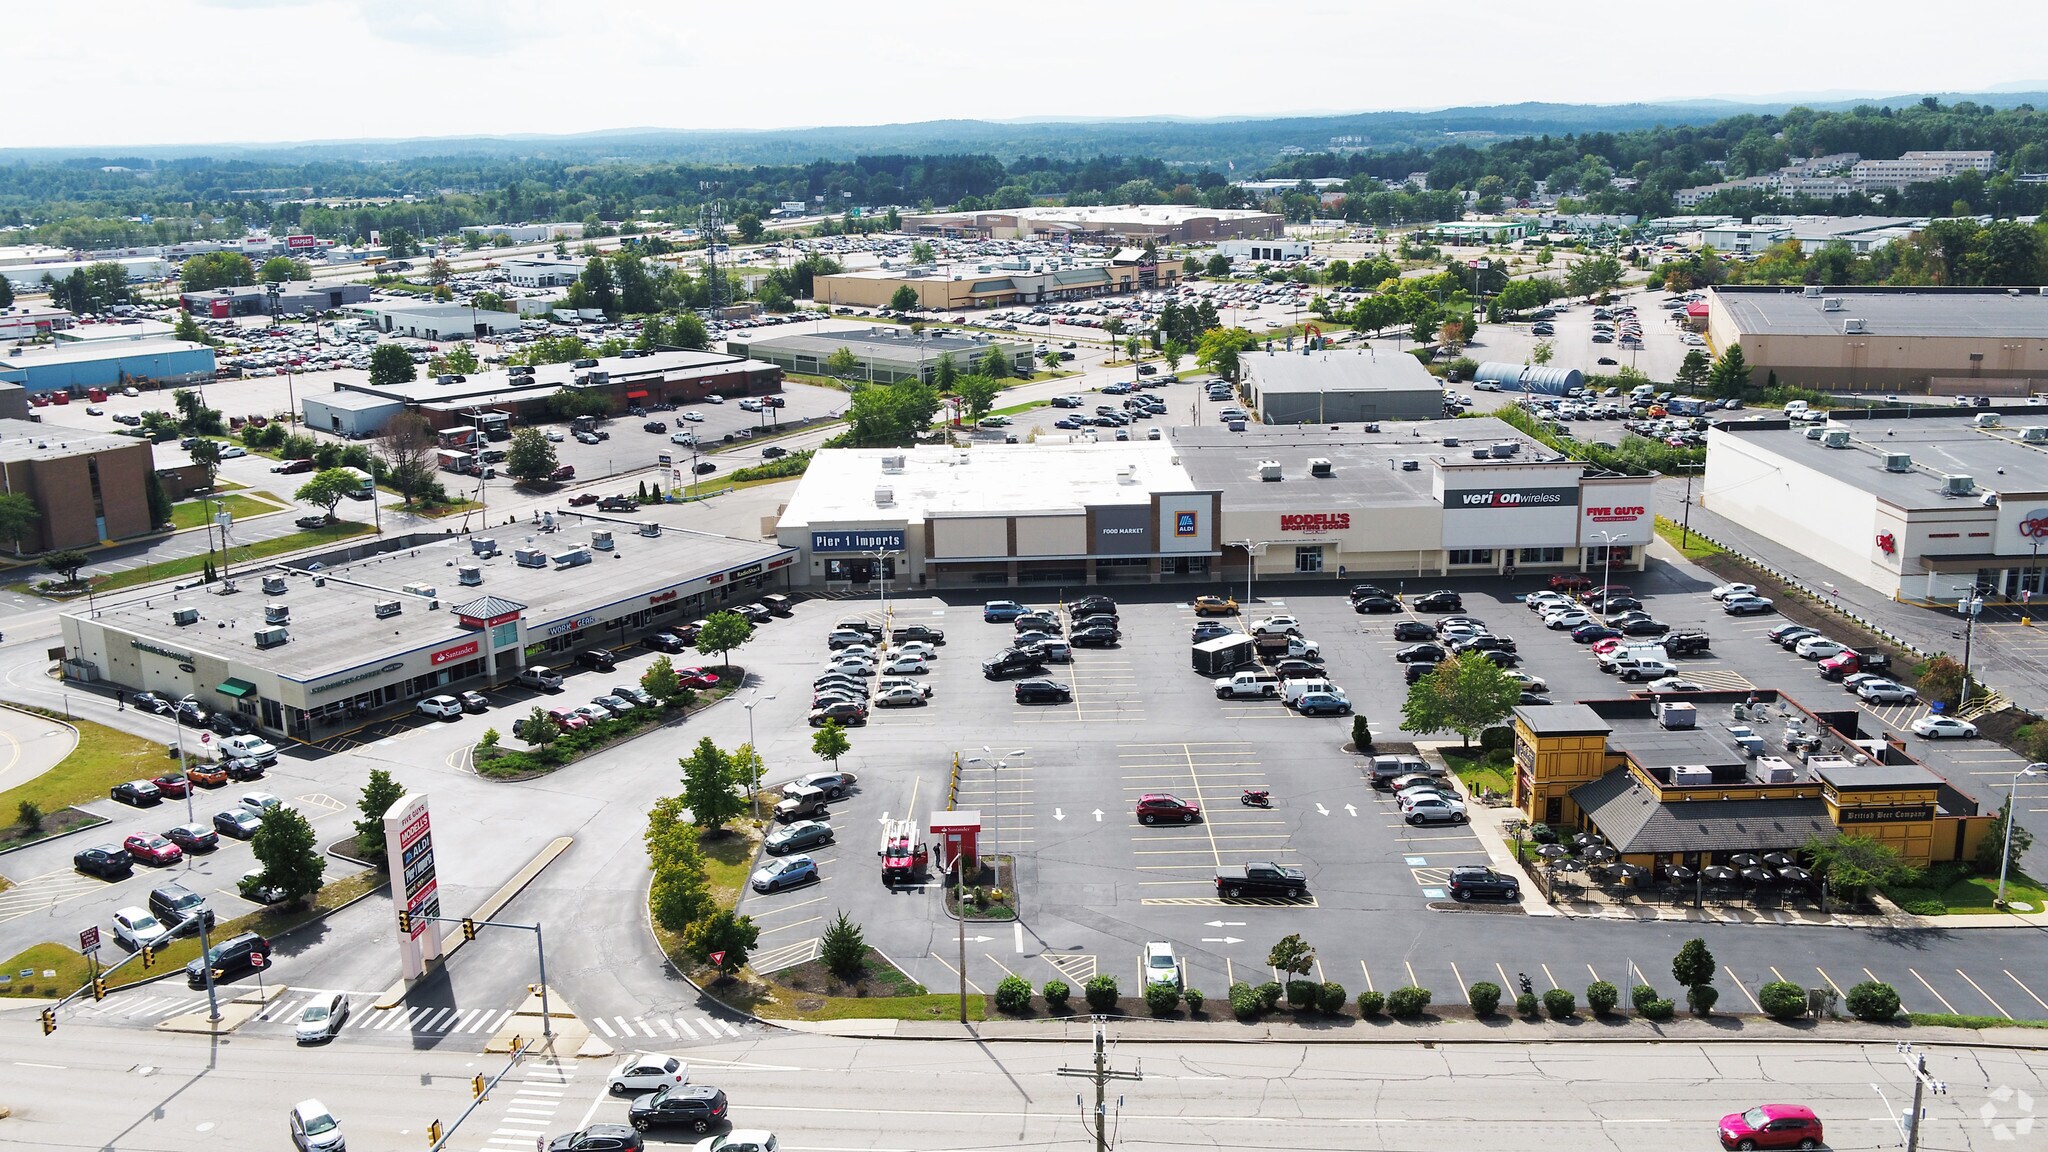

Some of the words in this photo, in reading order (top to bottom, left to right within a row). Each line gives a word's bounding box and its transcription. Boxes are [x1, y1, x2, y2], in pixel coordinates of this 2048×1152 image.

[1520, 493, 1560, 503] wireless
[1587, 507, 1611, 516] FIVE
[1614, 506, 1645, 515] GUYS
[1281, 513, 1350, 525] MODELL'S
[816, 536, 840, 547] Pier
[845, 536, 850, 546] 1
[736, 566, 761, 578] RadioShack
[549, 621, 572, 635] WORK
[577, 616, 596, 628] GEAR
[445, 645, 475, 660] Santander
[401, 814, 412, 826] FIVE
[412, 804, 425, 818] GUYS
[1848, 812, 1875, 820] British
[1877, 811, 1893, 819] Beer
[1895, 811, 1926, 819] Company
[413, 837, 430, 858] ALDI
